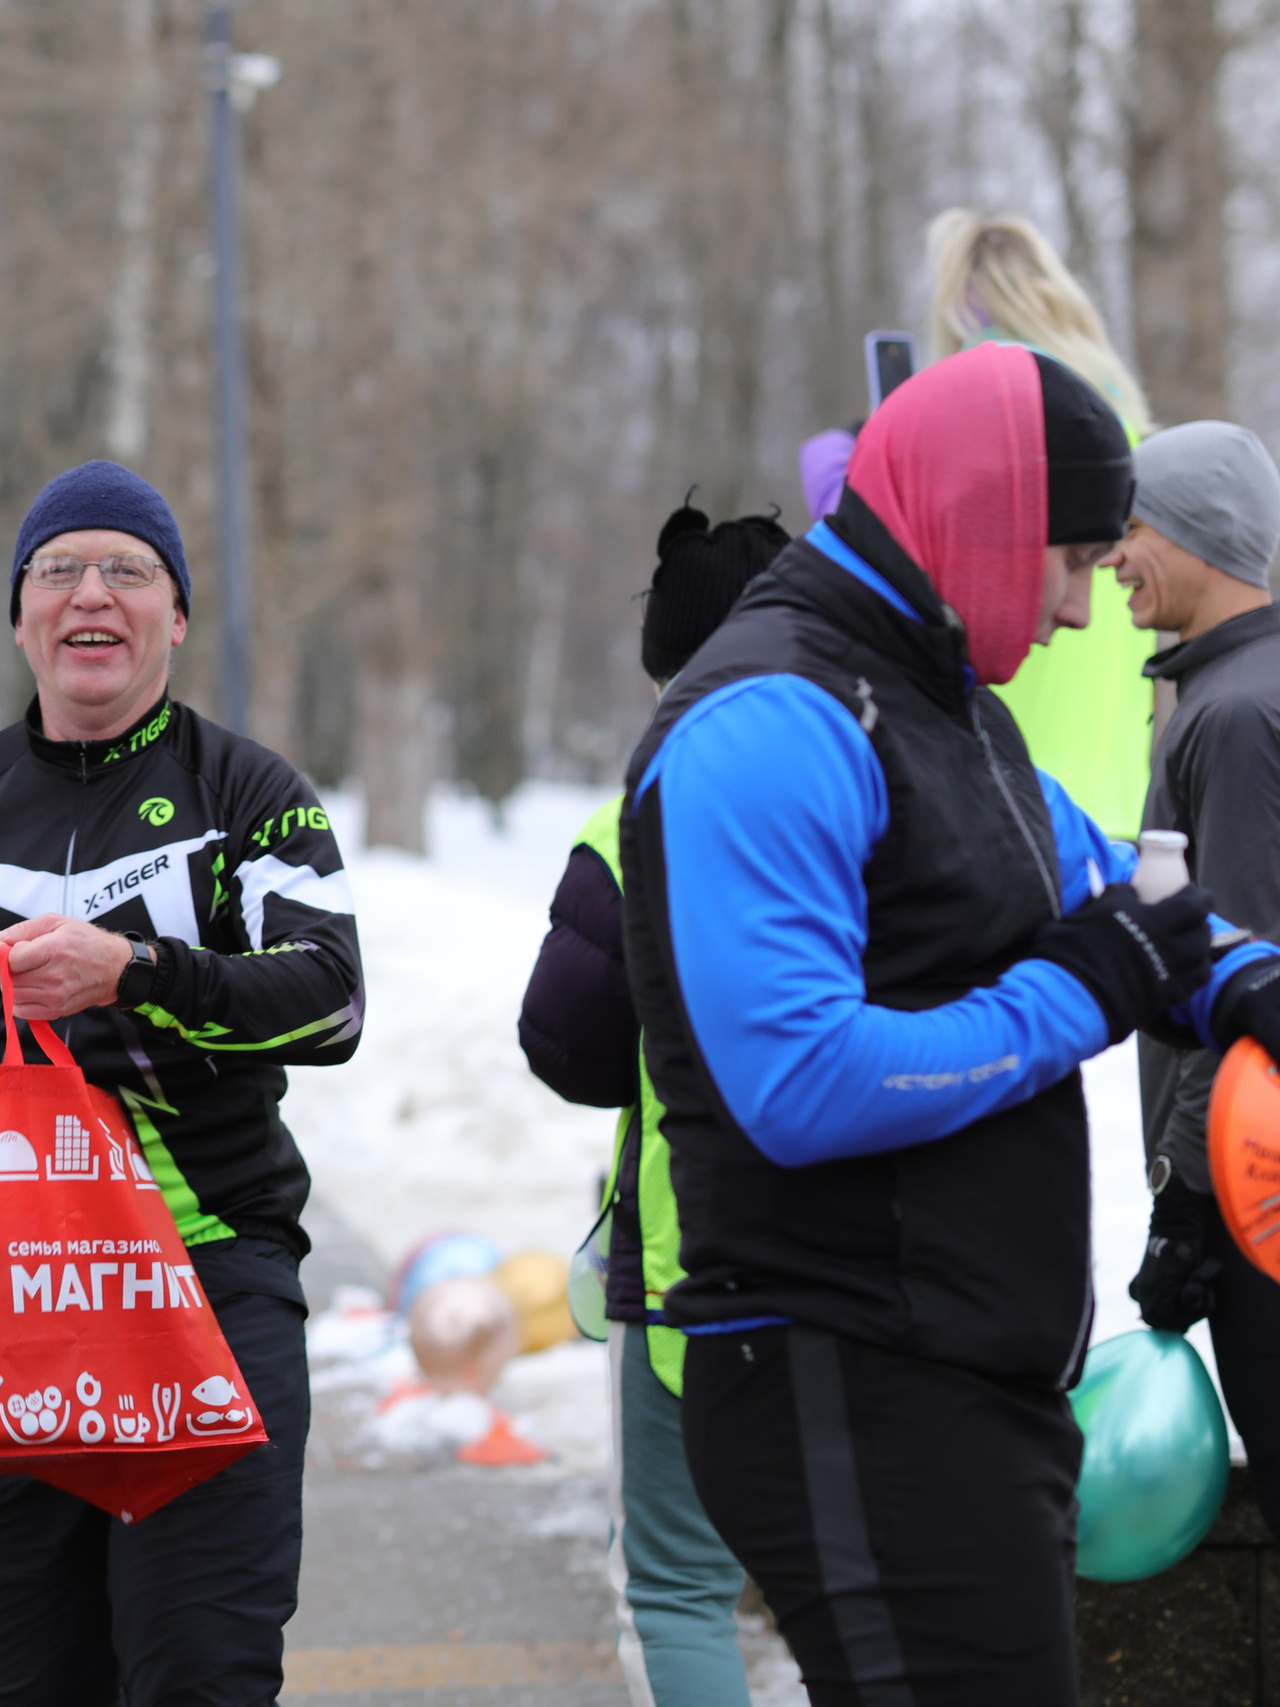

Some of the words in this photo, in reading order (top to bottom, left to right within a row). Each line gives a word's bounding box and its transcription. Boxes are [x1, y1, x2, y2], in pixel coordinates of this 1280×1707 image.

[84, 854, 170, 915] X-TIGER
[8, 1240, 62, 1258] семья
[67, 1238, 163, 1256] магазино
[10, 1261, 203, 1314] МАГНИТ
